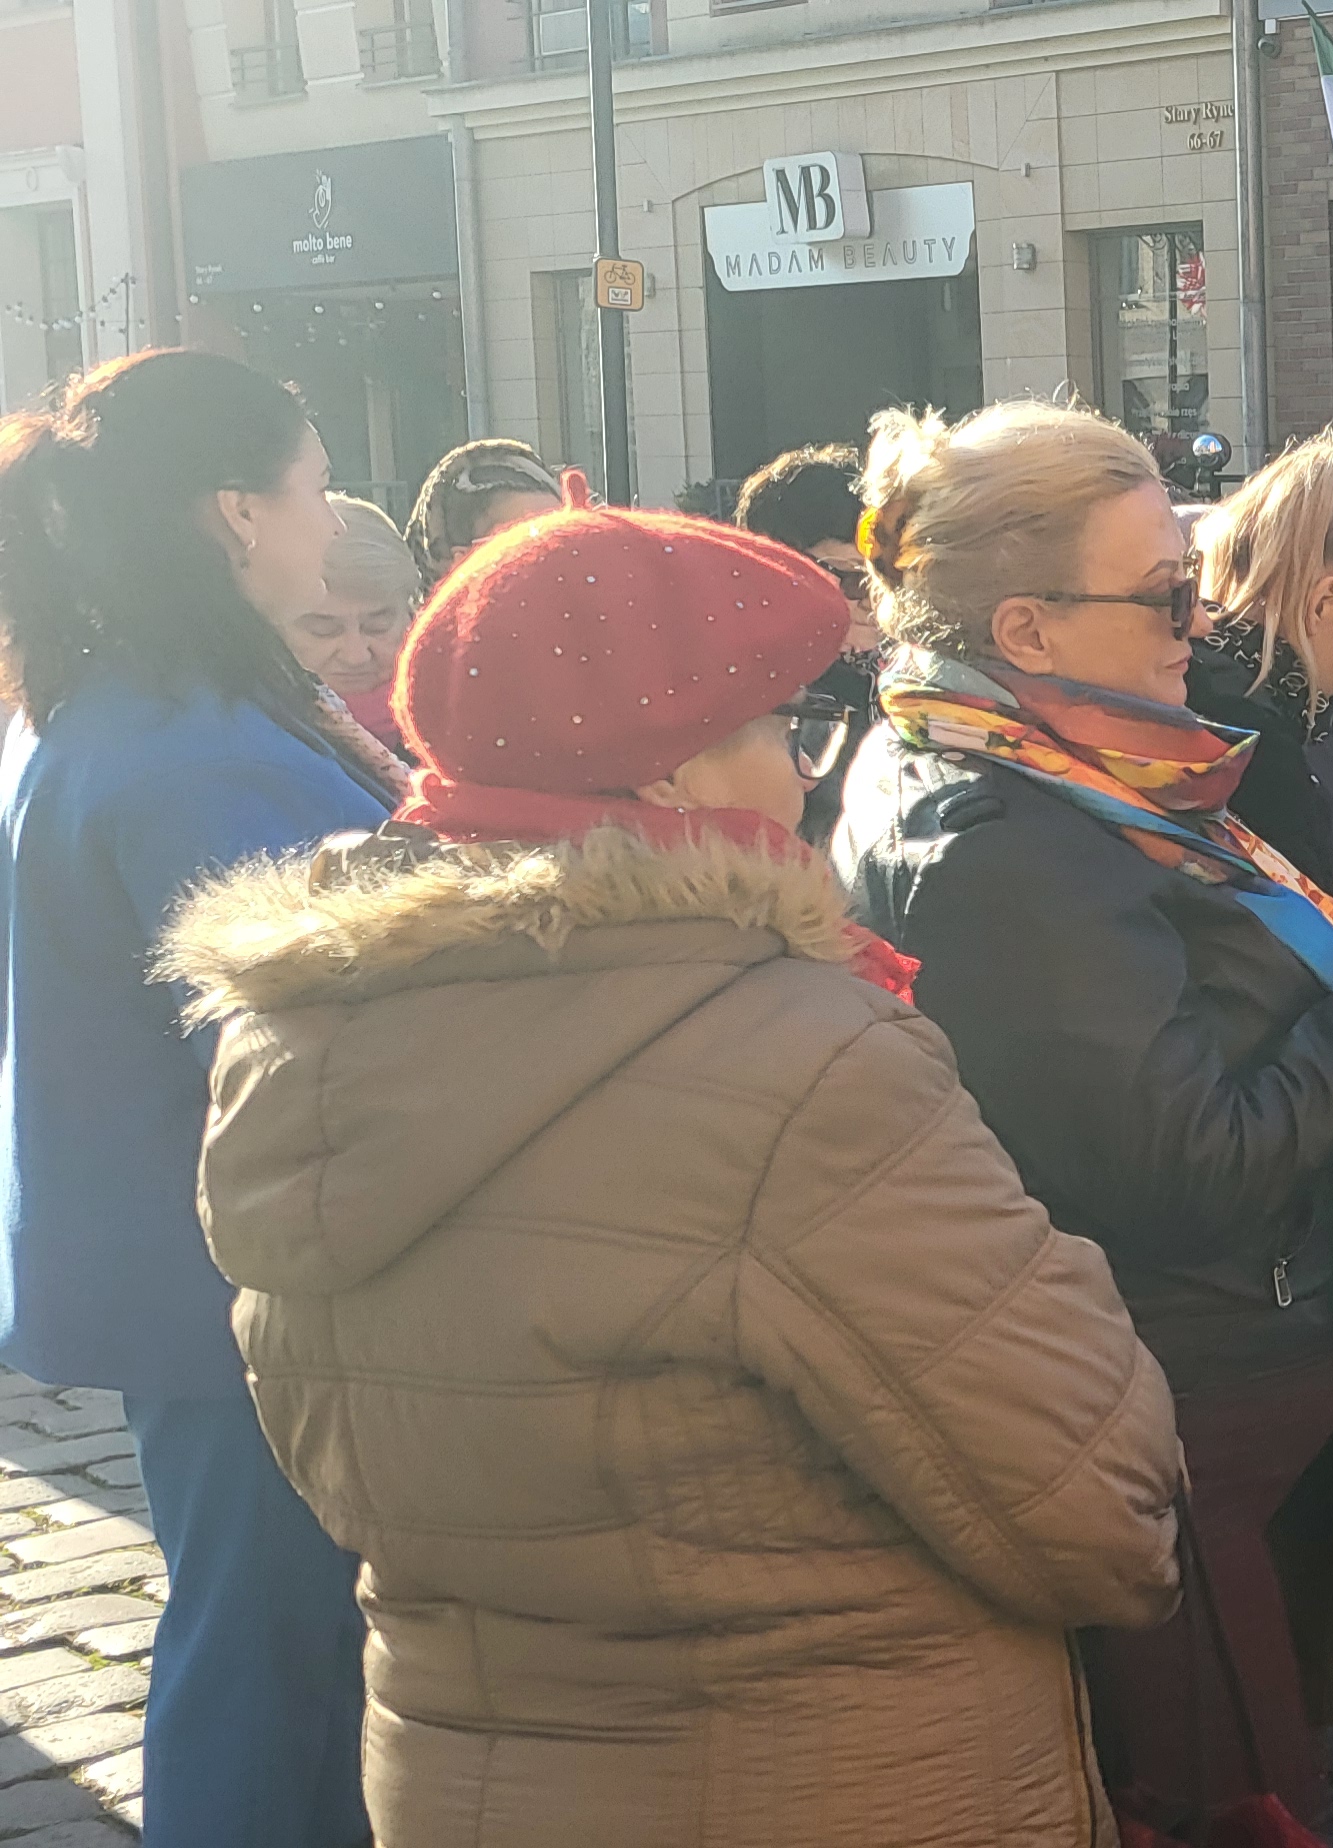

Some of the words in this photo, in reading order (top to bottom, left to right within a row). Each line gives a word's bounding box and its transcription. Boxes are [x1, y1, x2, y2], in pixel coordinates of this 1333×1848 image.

[1164, 105, 1200, 125] Stary
[1203, 102, 1234, 123] Ryne
[1187, 131, 1223, 150] 66-67
[772, 164, 837, 236] MB
[293, 233, 324, 253] molto
[326, 231, 352, 250] bene
[726, 247, 825, 278] MADAM
[844, 236, 956, 270] BEAUTY
